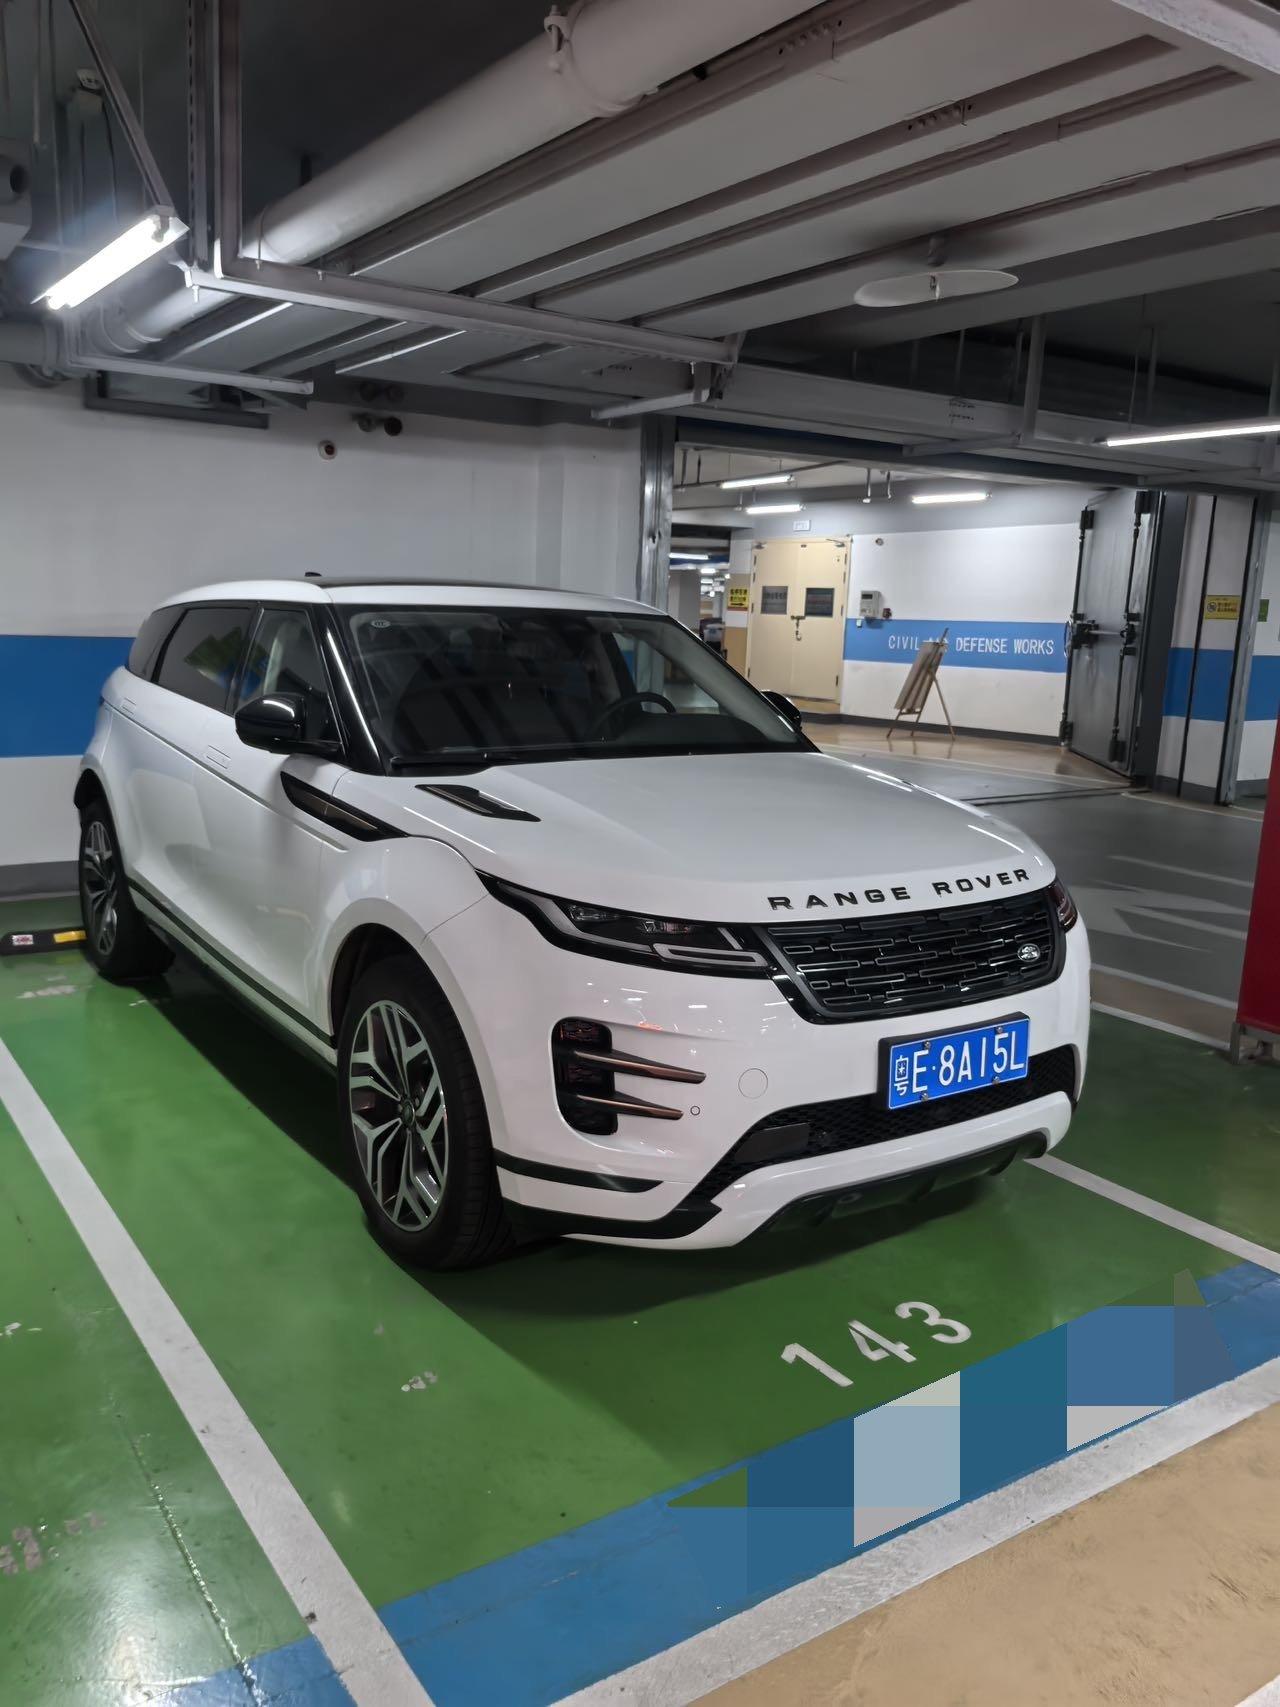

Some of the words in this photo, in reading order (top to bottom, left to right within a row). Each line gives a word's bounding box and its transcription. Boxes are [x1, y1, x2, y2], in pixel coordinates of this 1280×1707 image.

[888, 635, 919, 650] CIVIL
[955, 637, 1007, 654] DEFENSE
[1013, 638, 1054, 654] WORKS
[767, 886, 911, 911] RANGE
[932, 868, 1030, 896] ROVER
[781, 1301, 972, 1387] 143
